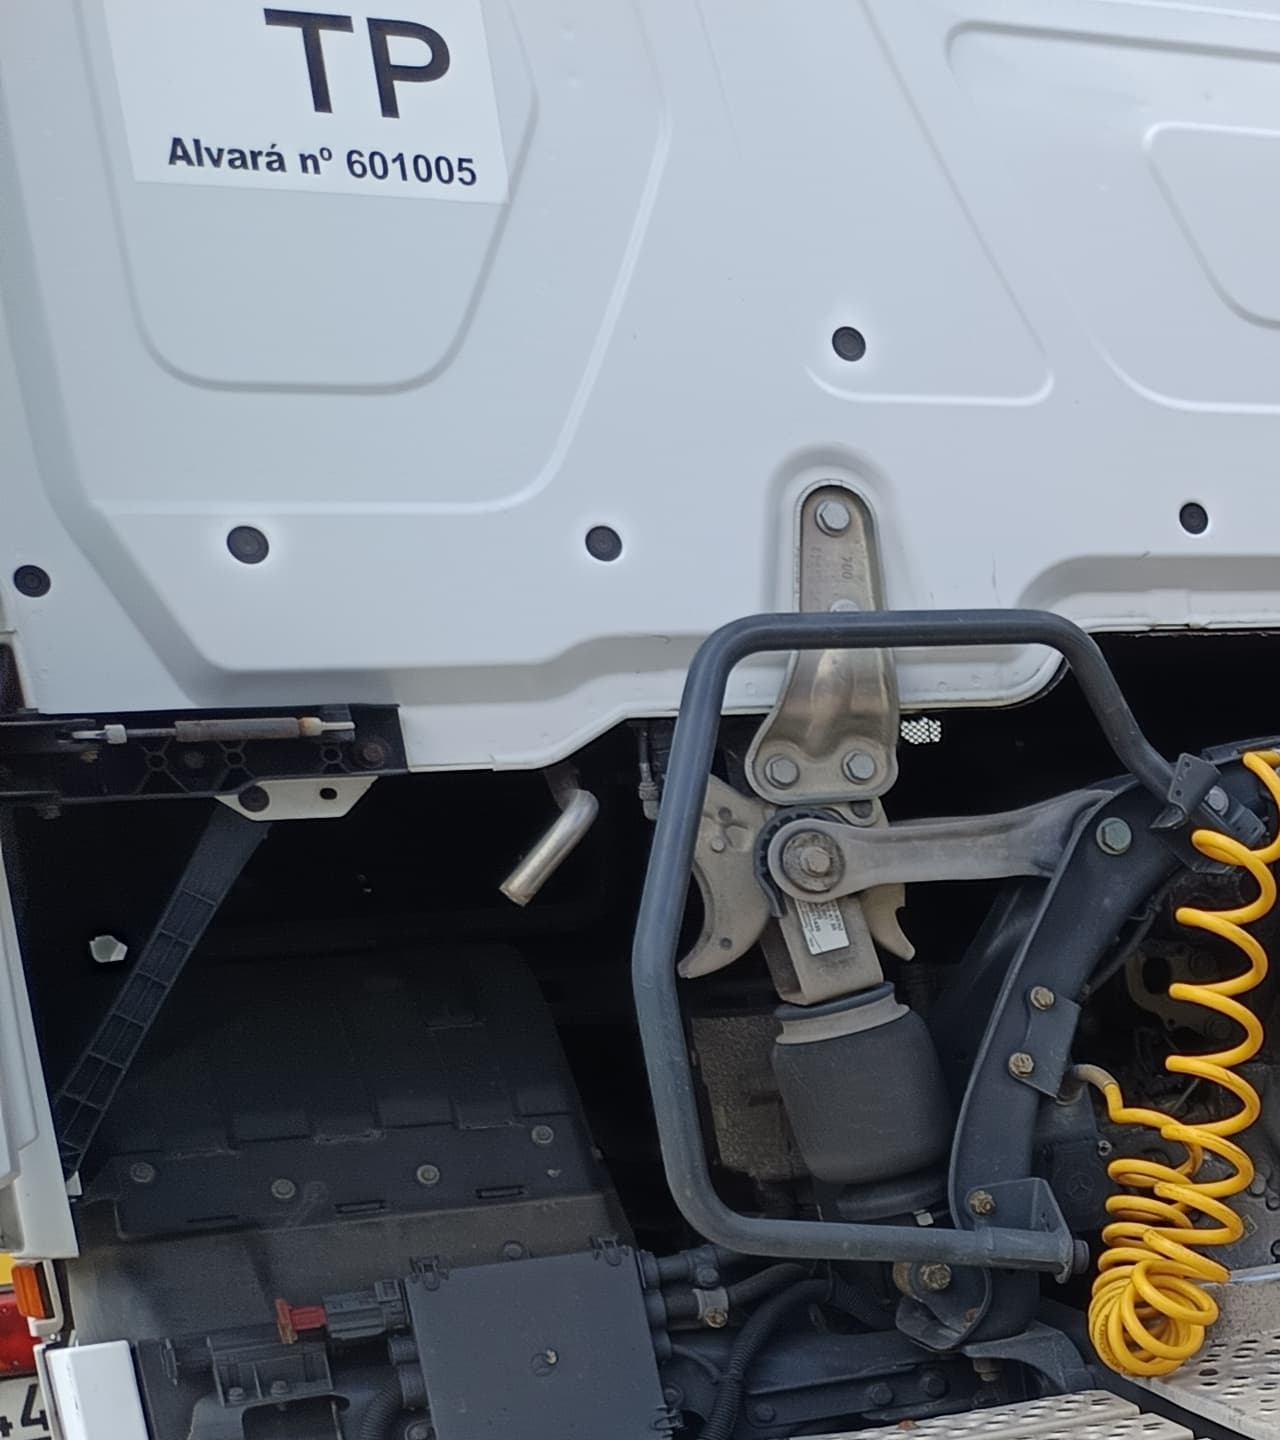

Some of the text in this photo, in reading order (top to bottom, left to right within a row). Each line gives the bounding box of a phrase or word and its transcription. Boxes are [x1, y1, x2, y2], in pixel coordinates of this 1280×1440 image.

[263, 8, 450, 118] TP
[168, 137, 477, 185] Alvará nº 601005
